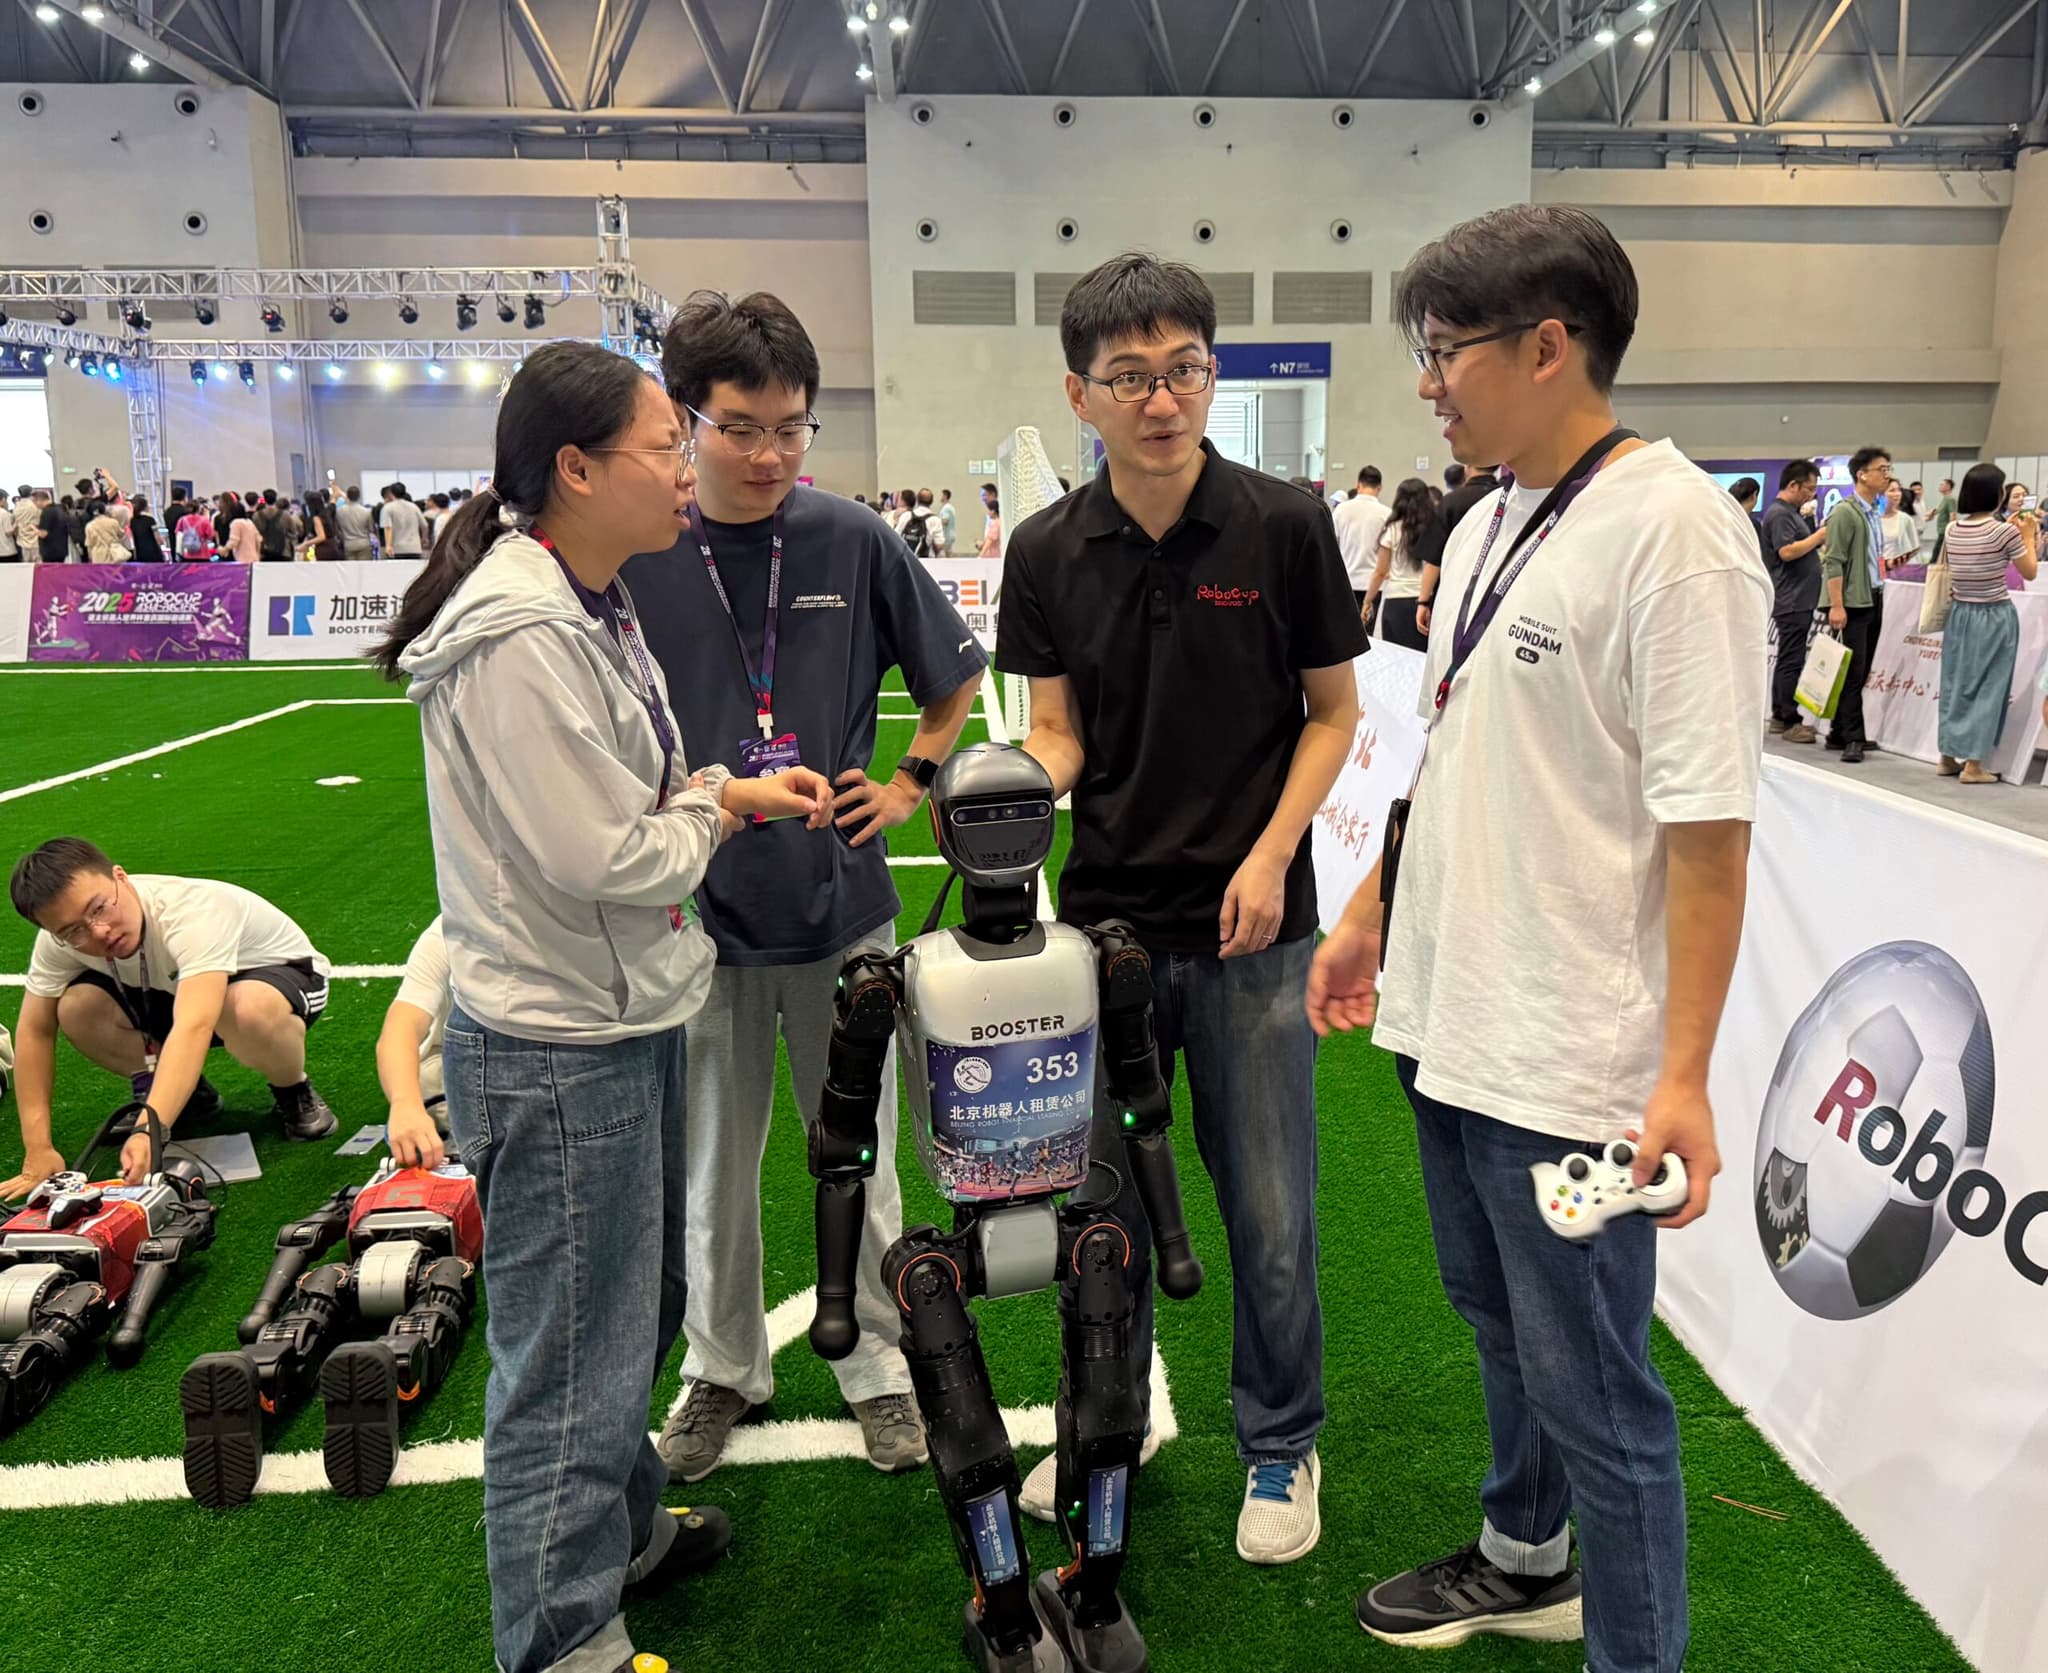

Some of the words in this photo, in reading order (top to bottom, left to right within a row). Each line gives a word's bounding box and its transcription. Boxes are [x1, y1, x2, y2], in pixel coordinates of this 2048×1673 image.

[1279, 361, 1296, 374] N7
[78, 591, 136, 613] 2025
[136, 592, 203, 603] ROBOCUP
[1197, 583, 1260, 606] RoboCup
[966, 612, 999, 633] 奥
[1519, 614, 1541, 629] MOBILE
[1541, 623, 1558, 635] SUIT
[1508, 623, 1562, 655] GUNDAM
[1903, 635, 1942, 648] CHONGQIN
[970, 1015, 1065, 1041] BOOSTER
[1026, 1051, 1079, 1084] 353
[949, 1089, 1087, 1121] 北京机器人租赁公司
